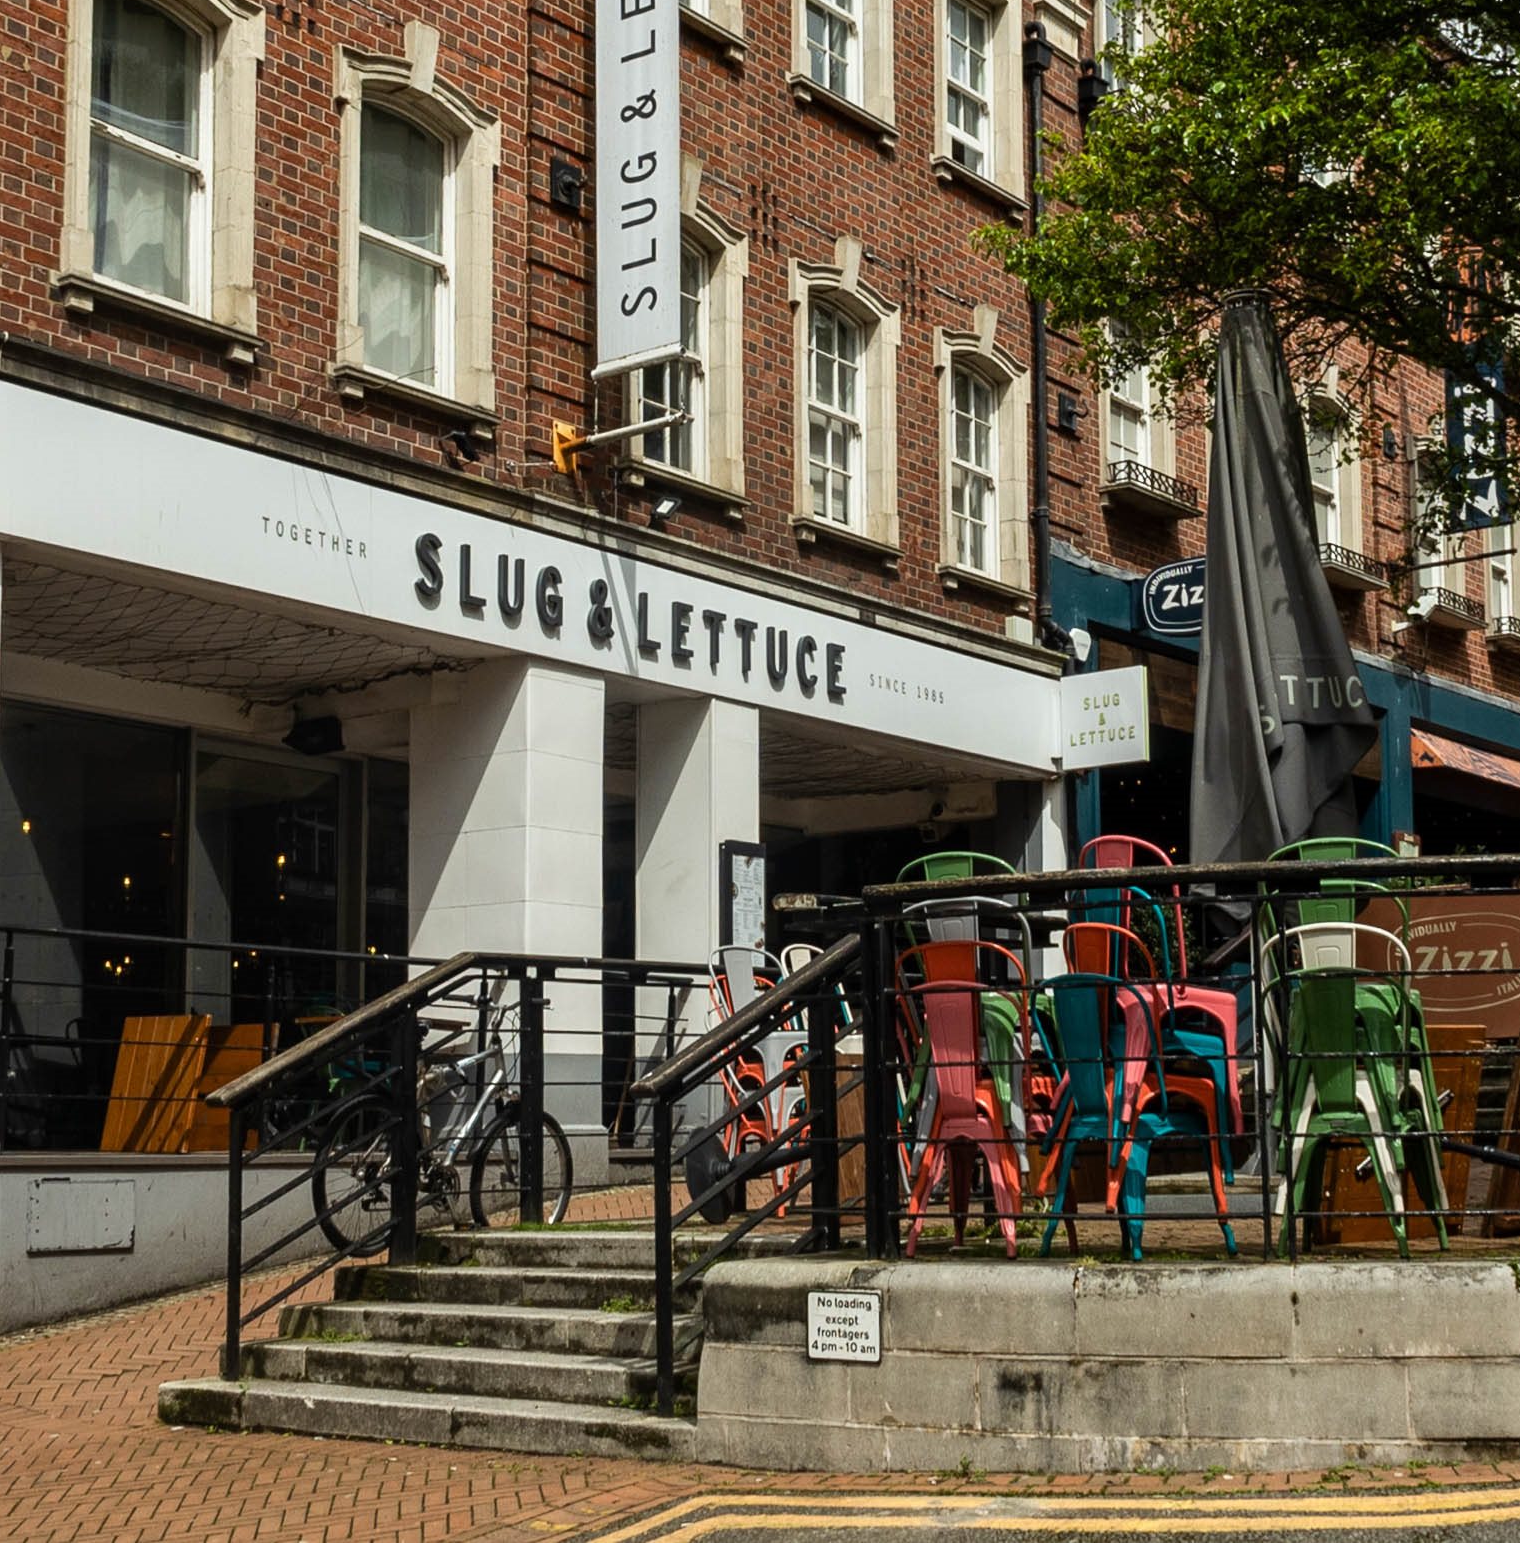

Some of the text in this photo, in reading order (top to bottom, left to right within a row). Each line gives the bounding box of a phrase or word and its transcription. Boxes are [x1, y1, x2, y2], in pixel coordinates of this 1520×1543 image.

[620, 88, 657, 123] &
[620, 151, 658, 317] SLUG
[261, 515, 368, 560] TOGETHER
[1148, 564, 1194, 595] INDIVIDUALLY
[1161, 583, 1205, 610] Ziz
[414, 532, 847, 697] SLUG & LETTUCE
[869, 673, 945, 705] SINCE 1985
[1083, 693, 1121, 711] SLUG
[1098, 712, 1107, 726] &
[1070, 725, 1136, 747] LETTUCE
[1414, 942, 1513, 979] Zizzi
[817, 1296, 872, 1312] No loading
[817, 1326, 870, 1341] frontagers
[825, 1315, 859, 1327] except
[811, 1339, 819, 1350] 4
[821, 1342, 837, 1352] pm
[845, 1341, 858, 1353] 10
[860, 1344, 876, 1354] am
